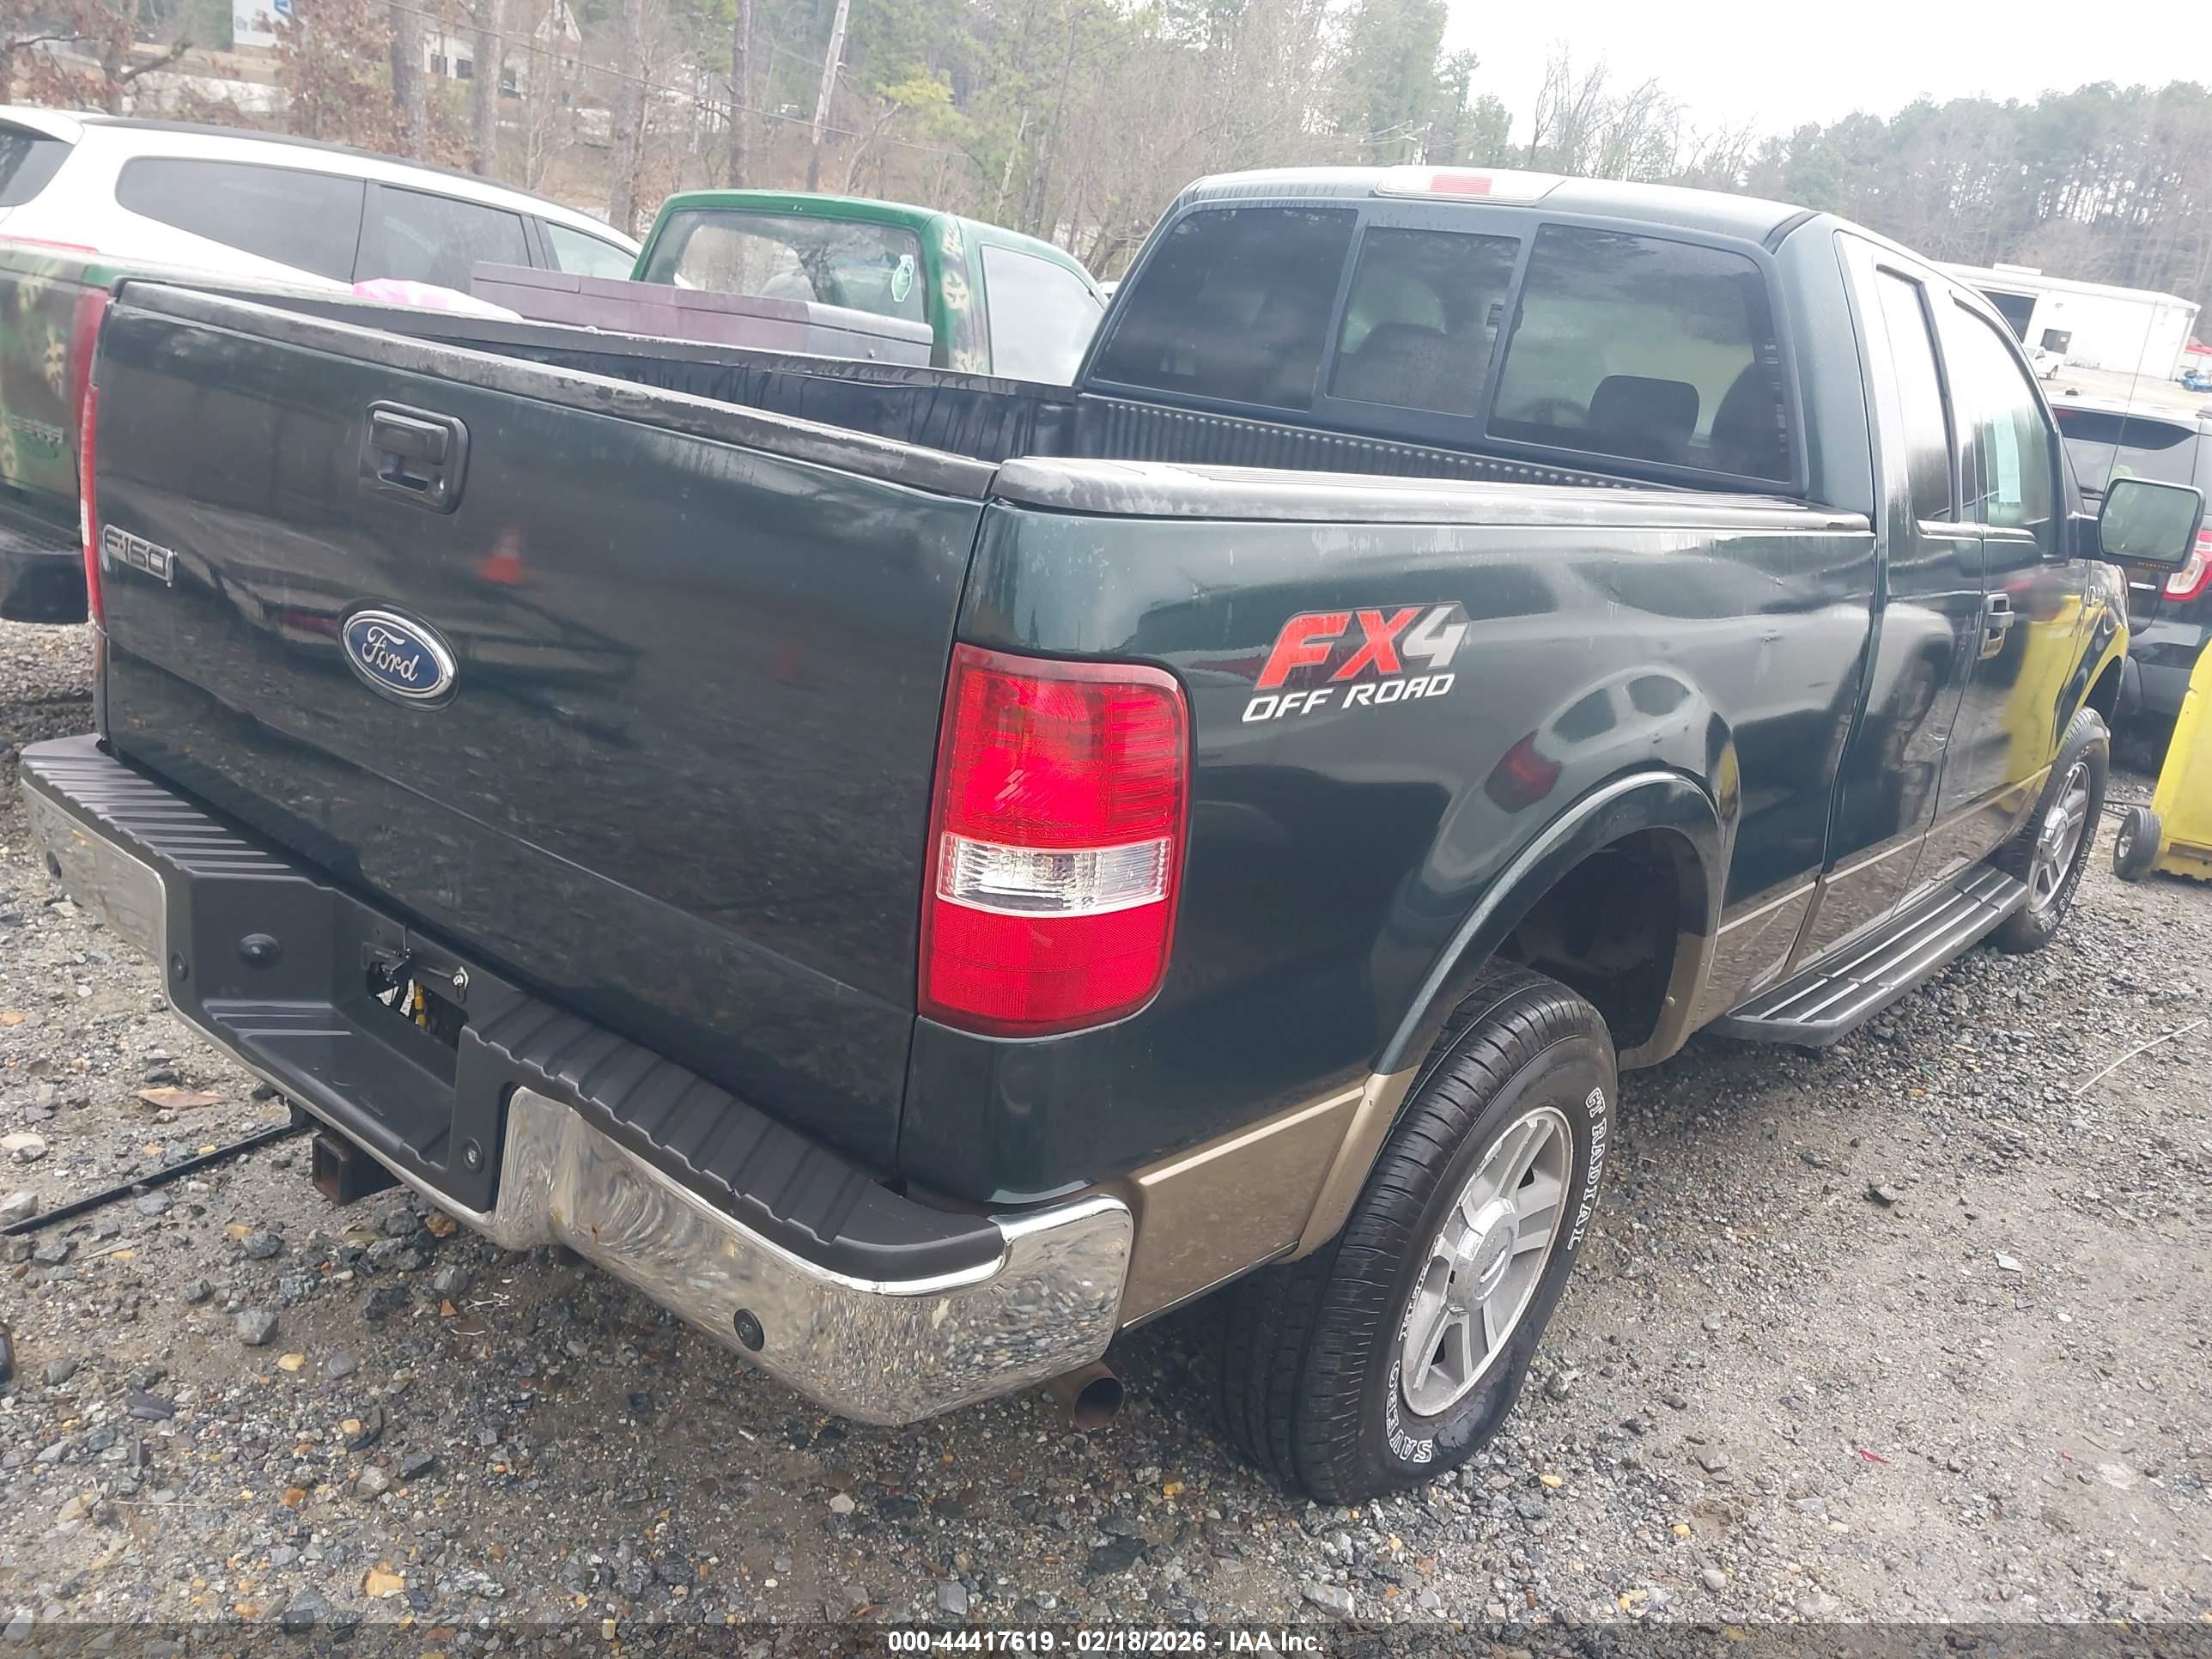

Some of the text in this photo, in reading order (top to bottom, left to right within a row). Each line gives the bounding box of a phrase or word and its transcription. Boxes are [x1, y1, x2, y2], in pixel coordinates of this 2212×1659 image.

[362, 626, 419, 682] Ford
[1254, 604, 1469, 690] FX4
[1242, 672, 1456, 722] OFF ROAD
[1567, 1087, 1607, 1250] GT RADIAL
[1386, 1359, 1433, 1463] SAVERO
